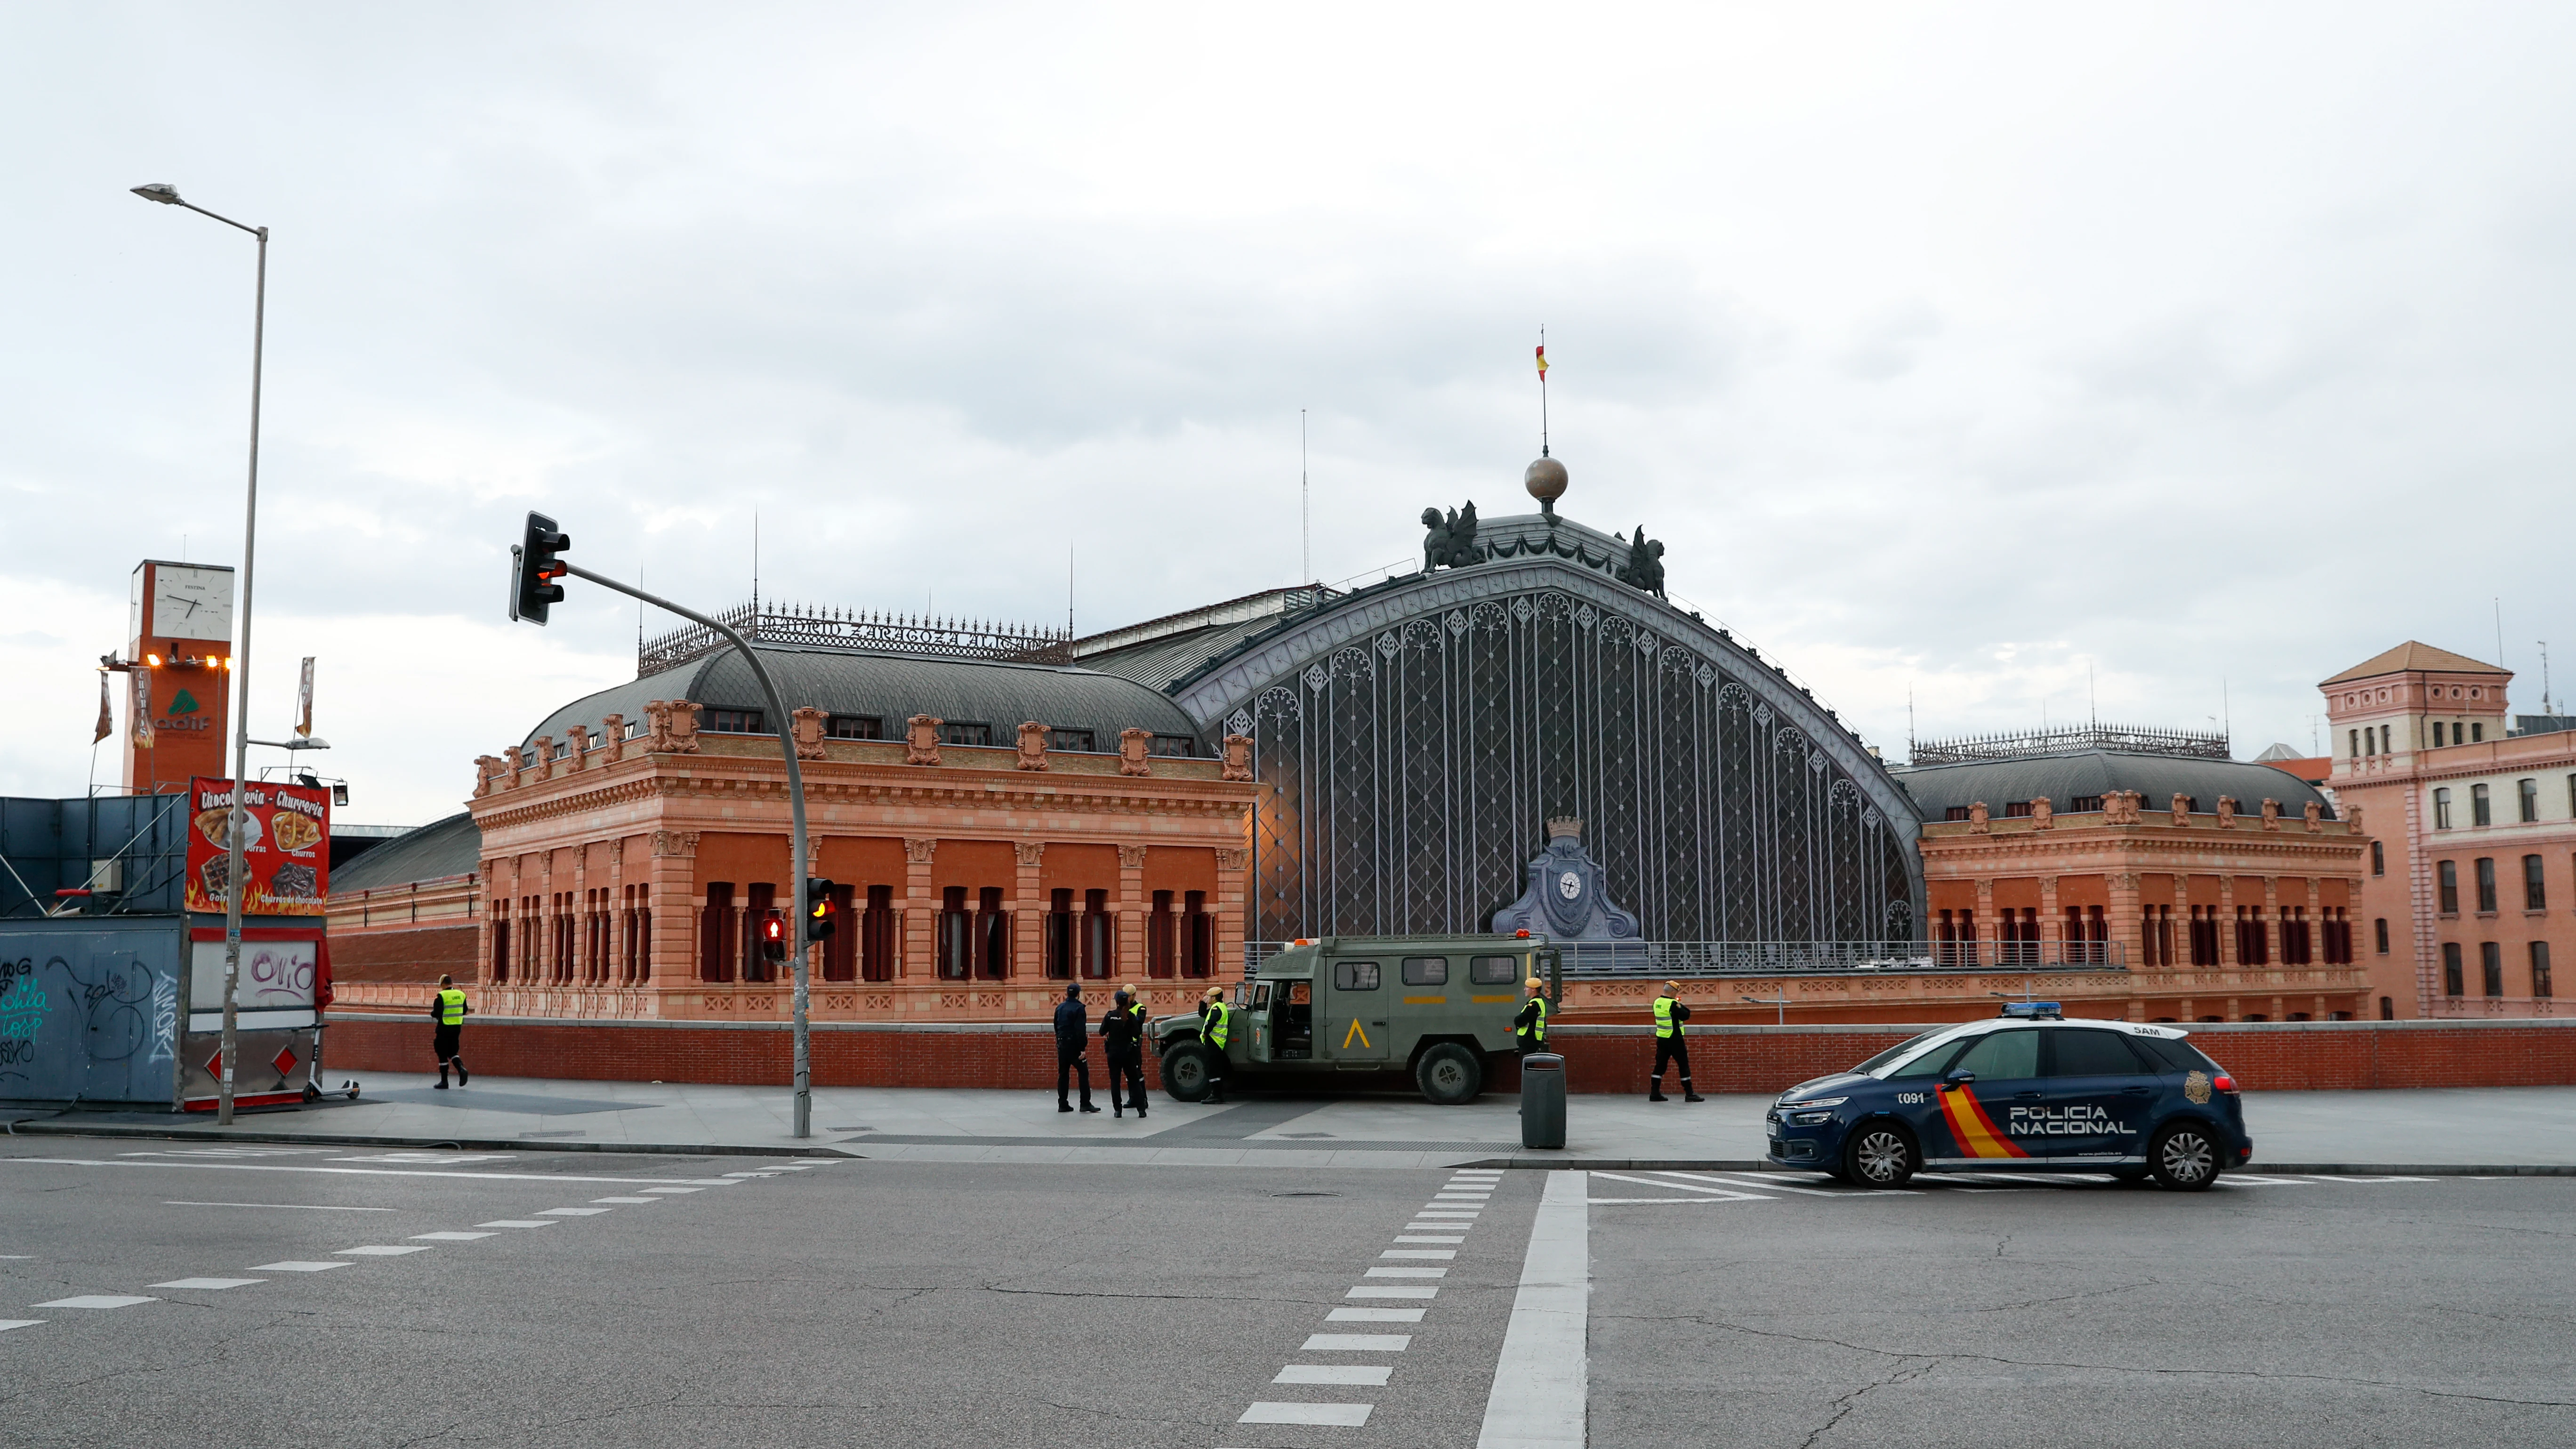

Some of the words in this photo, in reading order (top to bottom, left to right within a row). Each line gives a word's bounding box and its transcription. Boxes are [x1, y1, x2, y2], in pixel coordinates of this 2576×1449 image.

[849, 624, 958, 647] ZARAGOZA
[153, 716, 210, 731] adif
[201, 789, 265, 809] Chocoleria
[245, 844, 266, 853] Porras
[291, 849, 315, 858] Churros
[261, 894, 285, 903] Churros
[287, 895, 293, 903] de
[295, 895, 322, 904] chocolate
[2133, 1027, 2160, 1036] 5AM
[1904, 1093, 1924, 1103] 091
[2010, 1103, 2108, 1119] POLICÍA
[2010, 1121, 2137, 1134] NACIONAL
